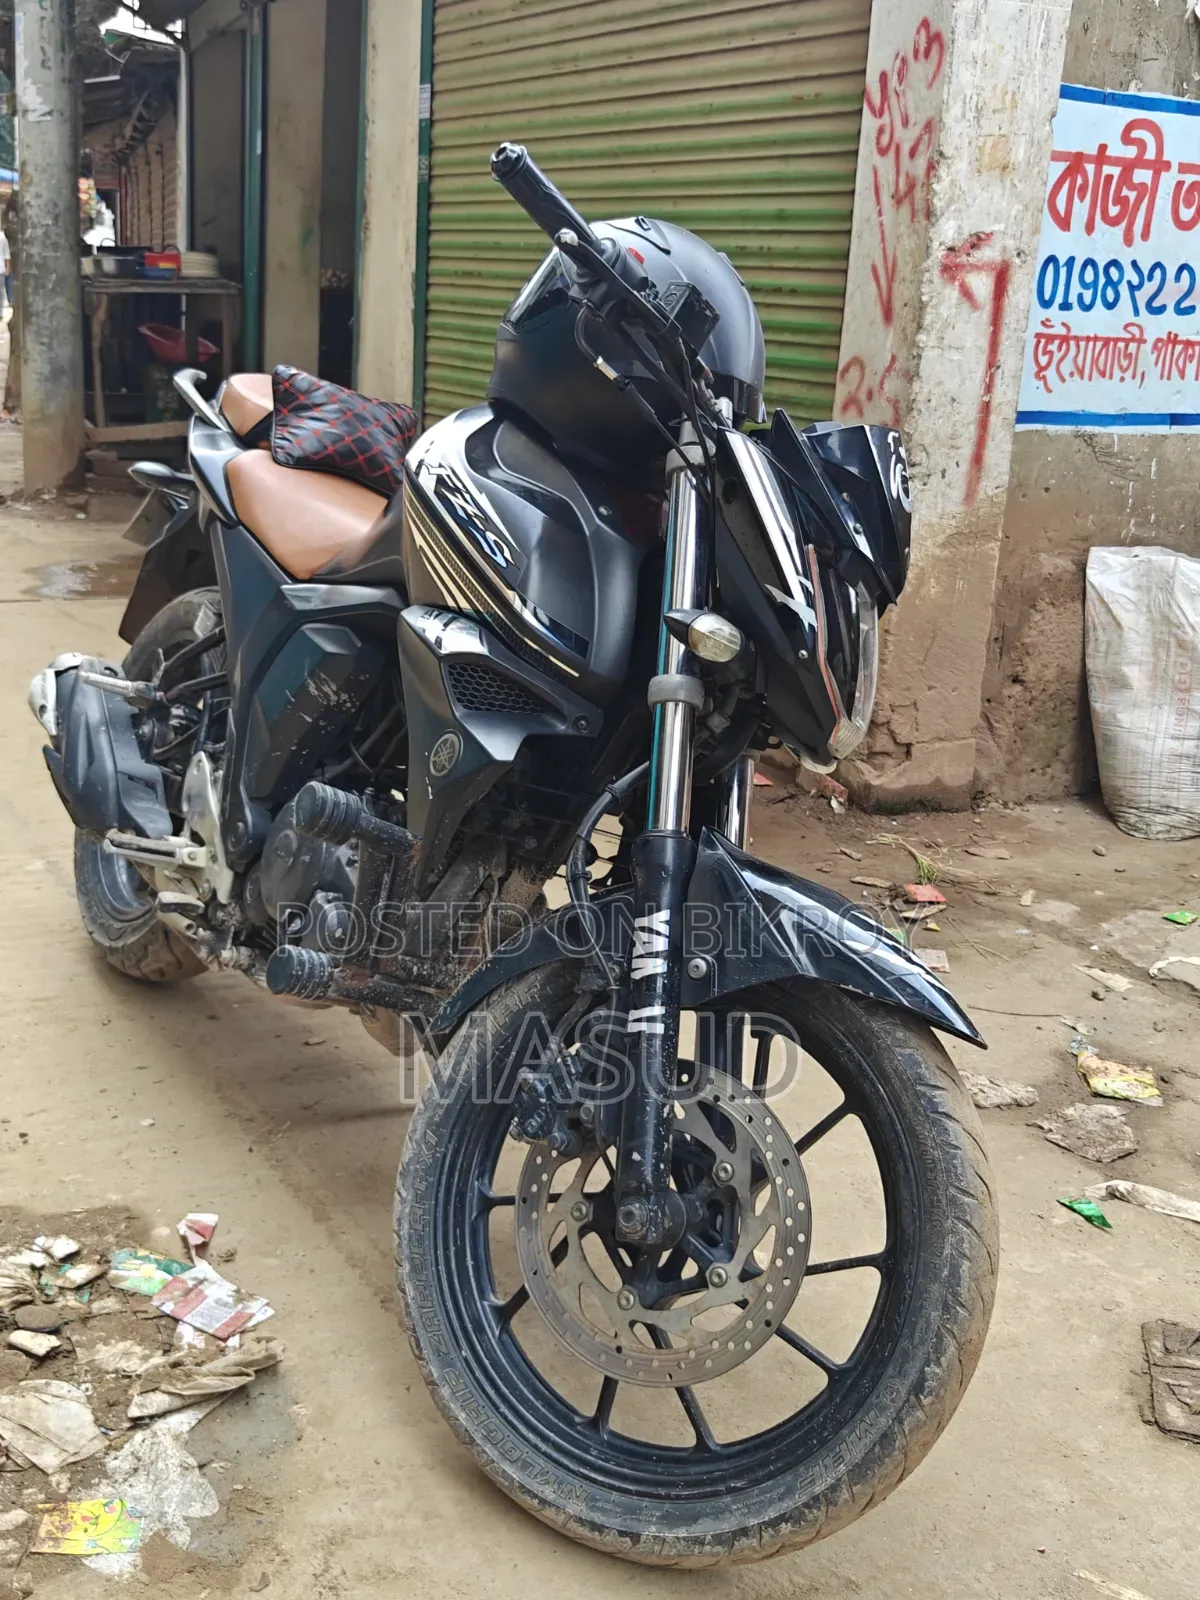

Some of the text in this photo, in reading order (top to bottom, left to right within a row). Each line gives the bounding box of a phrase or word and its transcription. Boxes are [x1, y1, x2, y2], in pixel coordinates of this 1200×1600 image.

[1047, 117, 1172, 248] কাজী
[444, 1367, 592, 1507] NYLOGRIP
[797, 1408, 882, 1498] MRF
